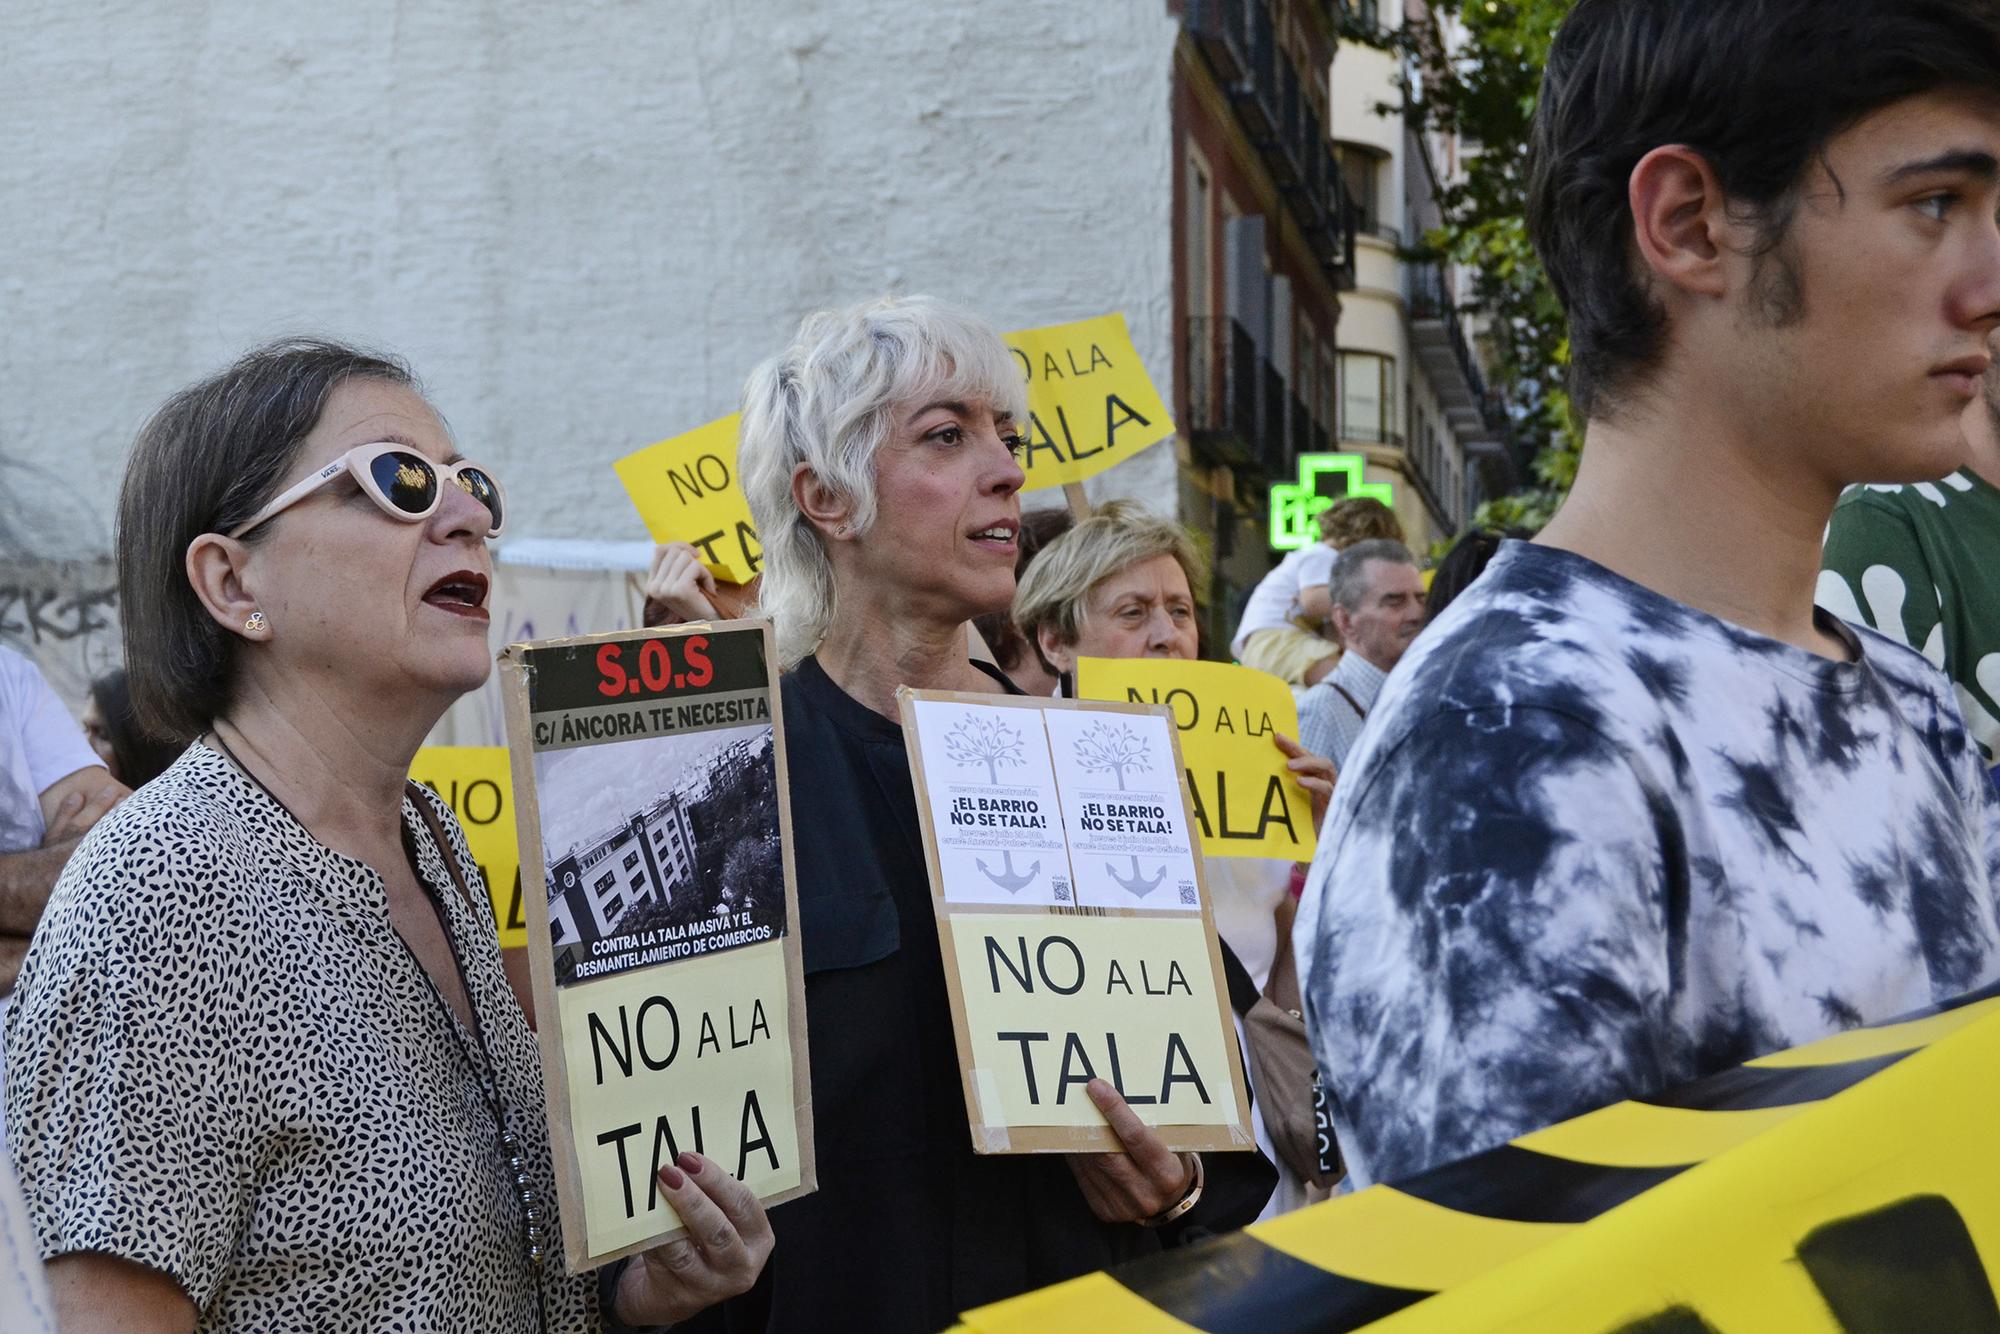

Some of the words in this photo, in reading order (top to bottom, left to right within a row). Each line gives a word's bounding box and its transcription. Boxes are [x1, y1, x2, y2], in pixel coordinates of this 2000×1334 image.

[1044, 351, 1065, 382] A
[1066, 342, 1113, 376] LA
[1026, 393, 1152, 469] ALA
[667, 454, 730, 506] NO
[690, 520, 763, 573] TA
[596, 635, 714, 697] S.O.S
[535, 721, 556, 746] C/
[561, 711, 647, 743] ÁNCORA
[648, 707, 675, 732] TE
[677, 697, 769, 728] NECESITA
[1215, 706, 1236, 735] A
[1244, 708, 1276, 737] LA
[950, 811, 975, 826] NO
[977, 813, 997, 826] SE
[998, 814, 1047, 829] TALA!
[952, 797, 976, 813] ¡EL
[978, 798, 1039, 814] BARRIO
[1080, 817, 1104, 831] NO
[1106, 819, 1125, 832] SE
[1126, 820, 1173, 835] TALA!
[1082, 803, 1105, 819] ¡EL
[1106, 804, 1165, 819] BARRIO
[1185, 768, 1299, 844] ALA
[576, 942, 691, 978] DESMANTELAMIENTO
[693, 938, 707, 954] DE
[708, 925, 771, 949] COMERCIOS
[592, 934, 639, 956] CONTRA
[642, 931, 656, 947] LA
[657, 924, 686, 943] TALA
[688, 915, 731, 937] MASIVA
[732, 913, 740, 928] Y
[741, 911, 753, 926] EL
[983, 935, 1086, 996] NO
[1106, 958, 1134, 995] A
[1140, 959, 1193, 996] LA
[587, 995, 681, 1086] NO
[697, 1011, 721, 1059] A
[728, 998, 771, 1050] LA
[996, 1031, 1212, 1106] TALA
